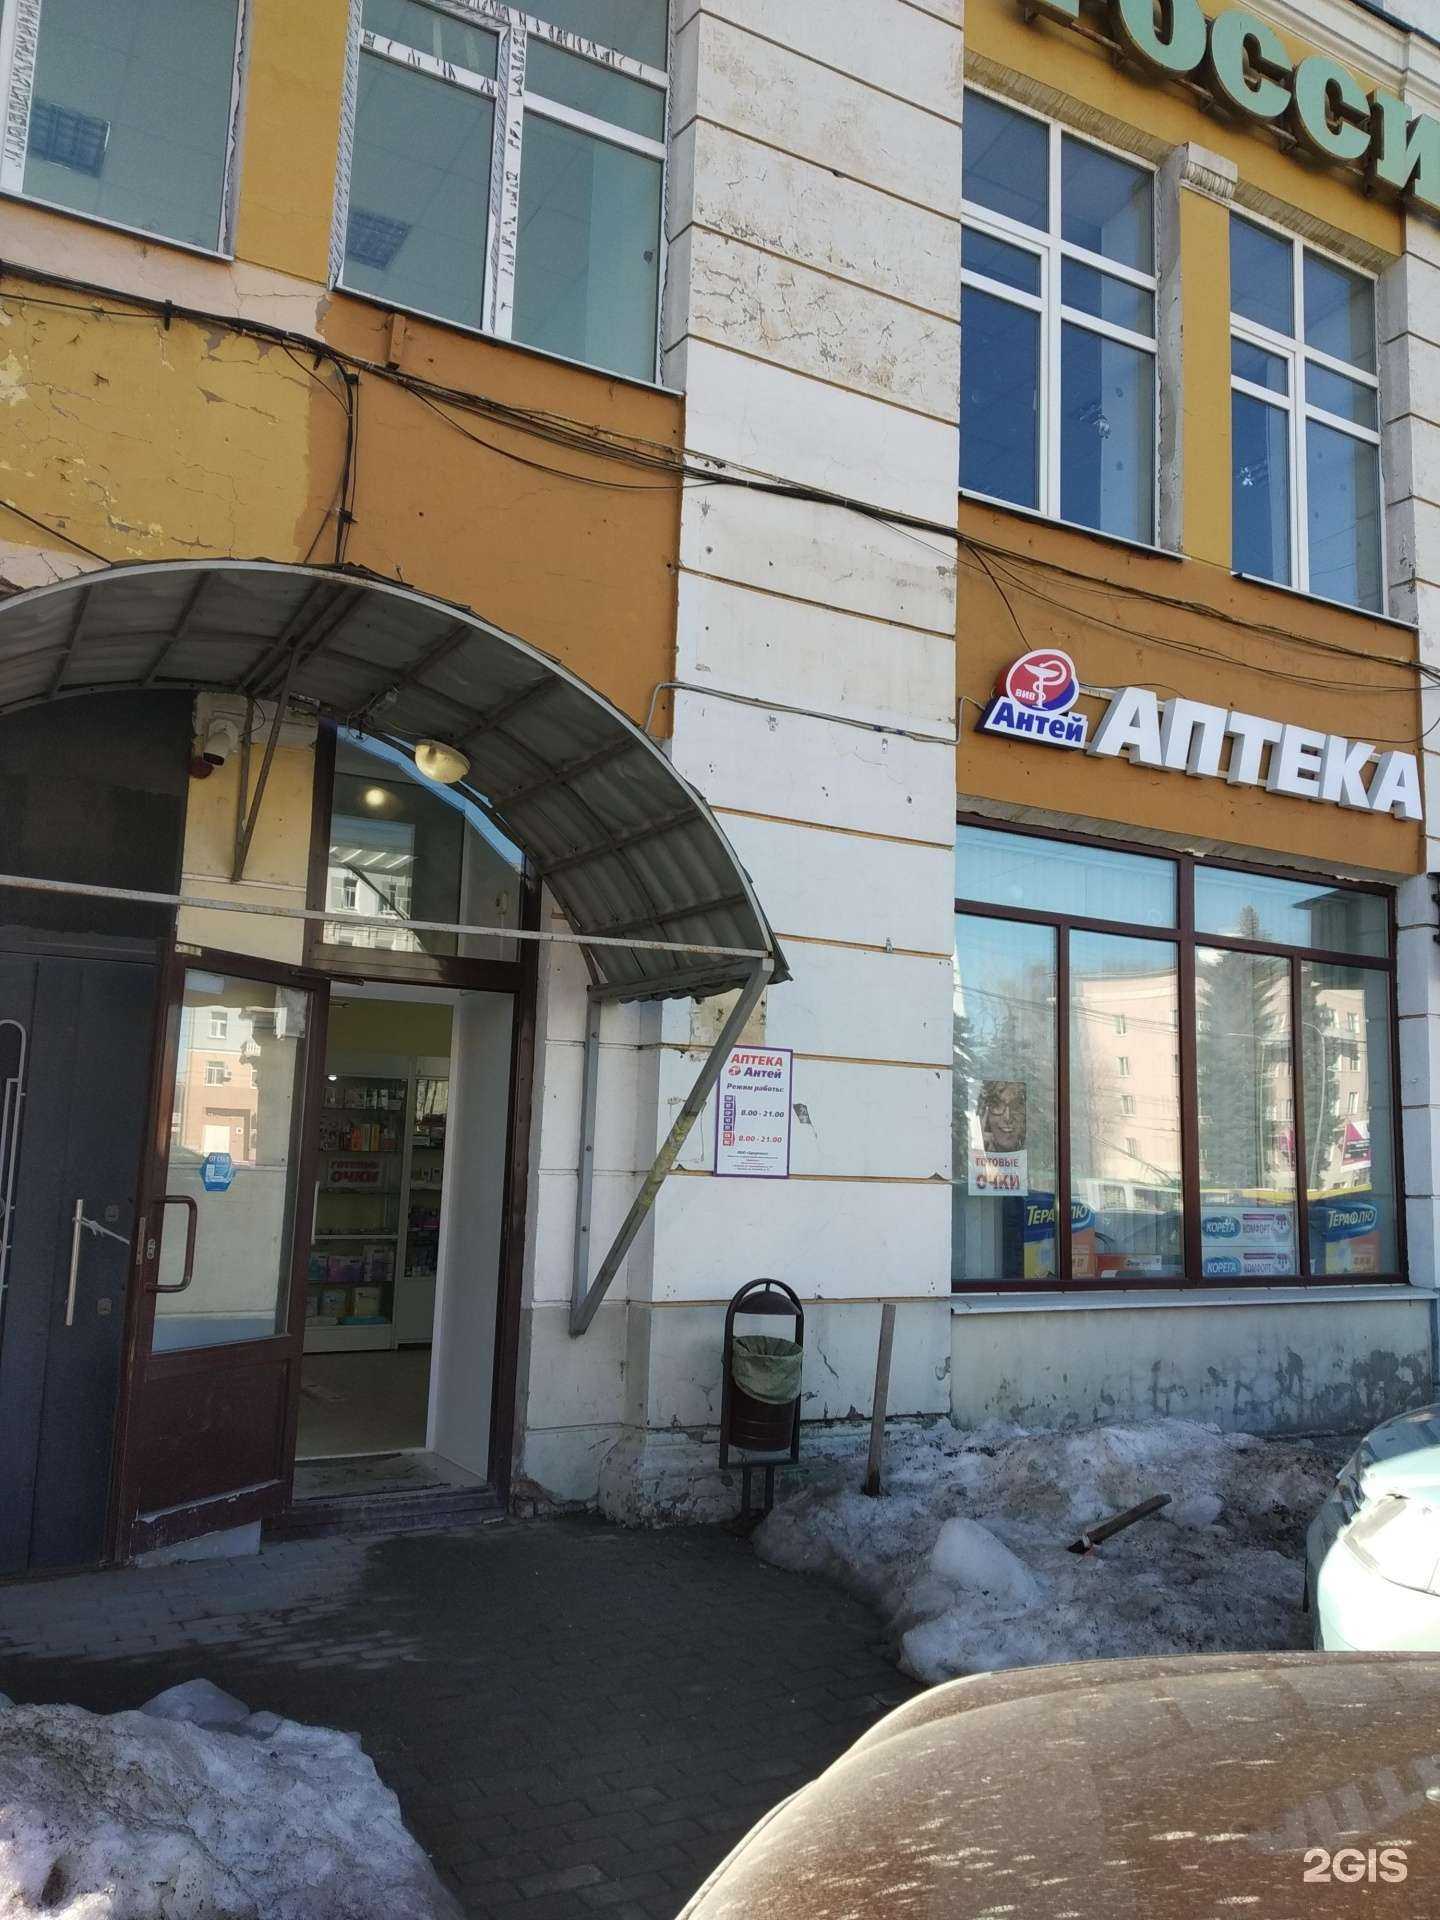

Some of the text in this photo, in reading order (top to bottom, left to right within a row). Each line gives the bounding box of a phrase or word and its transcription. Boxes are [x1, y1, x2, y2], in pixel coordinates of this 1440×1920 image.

[1020, 0, 1440, 210] ОССИ
[991, 702, 1084, 742] Антей
[1094, 687, 1423, 821] АПТЕКА
[731, 1054, 783, 1067] АПТЕКА
[744, 1067, 782, 1079] Антей
[975, 1157, 1020, 1169] ГОТОВЫЕ
[975, 1175, 1021, 1191] ОЧКИ
